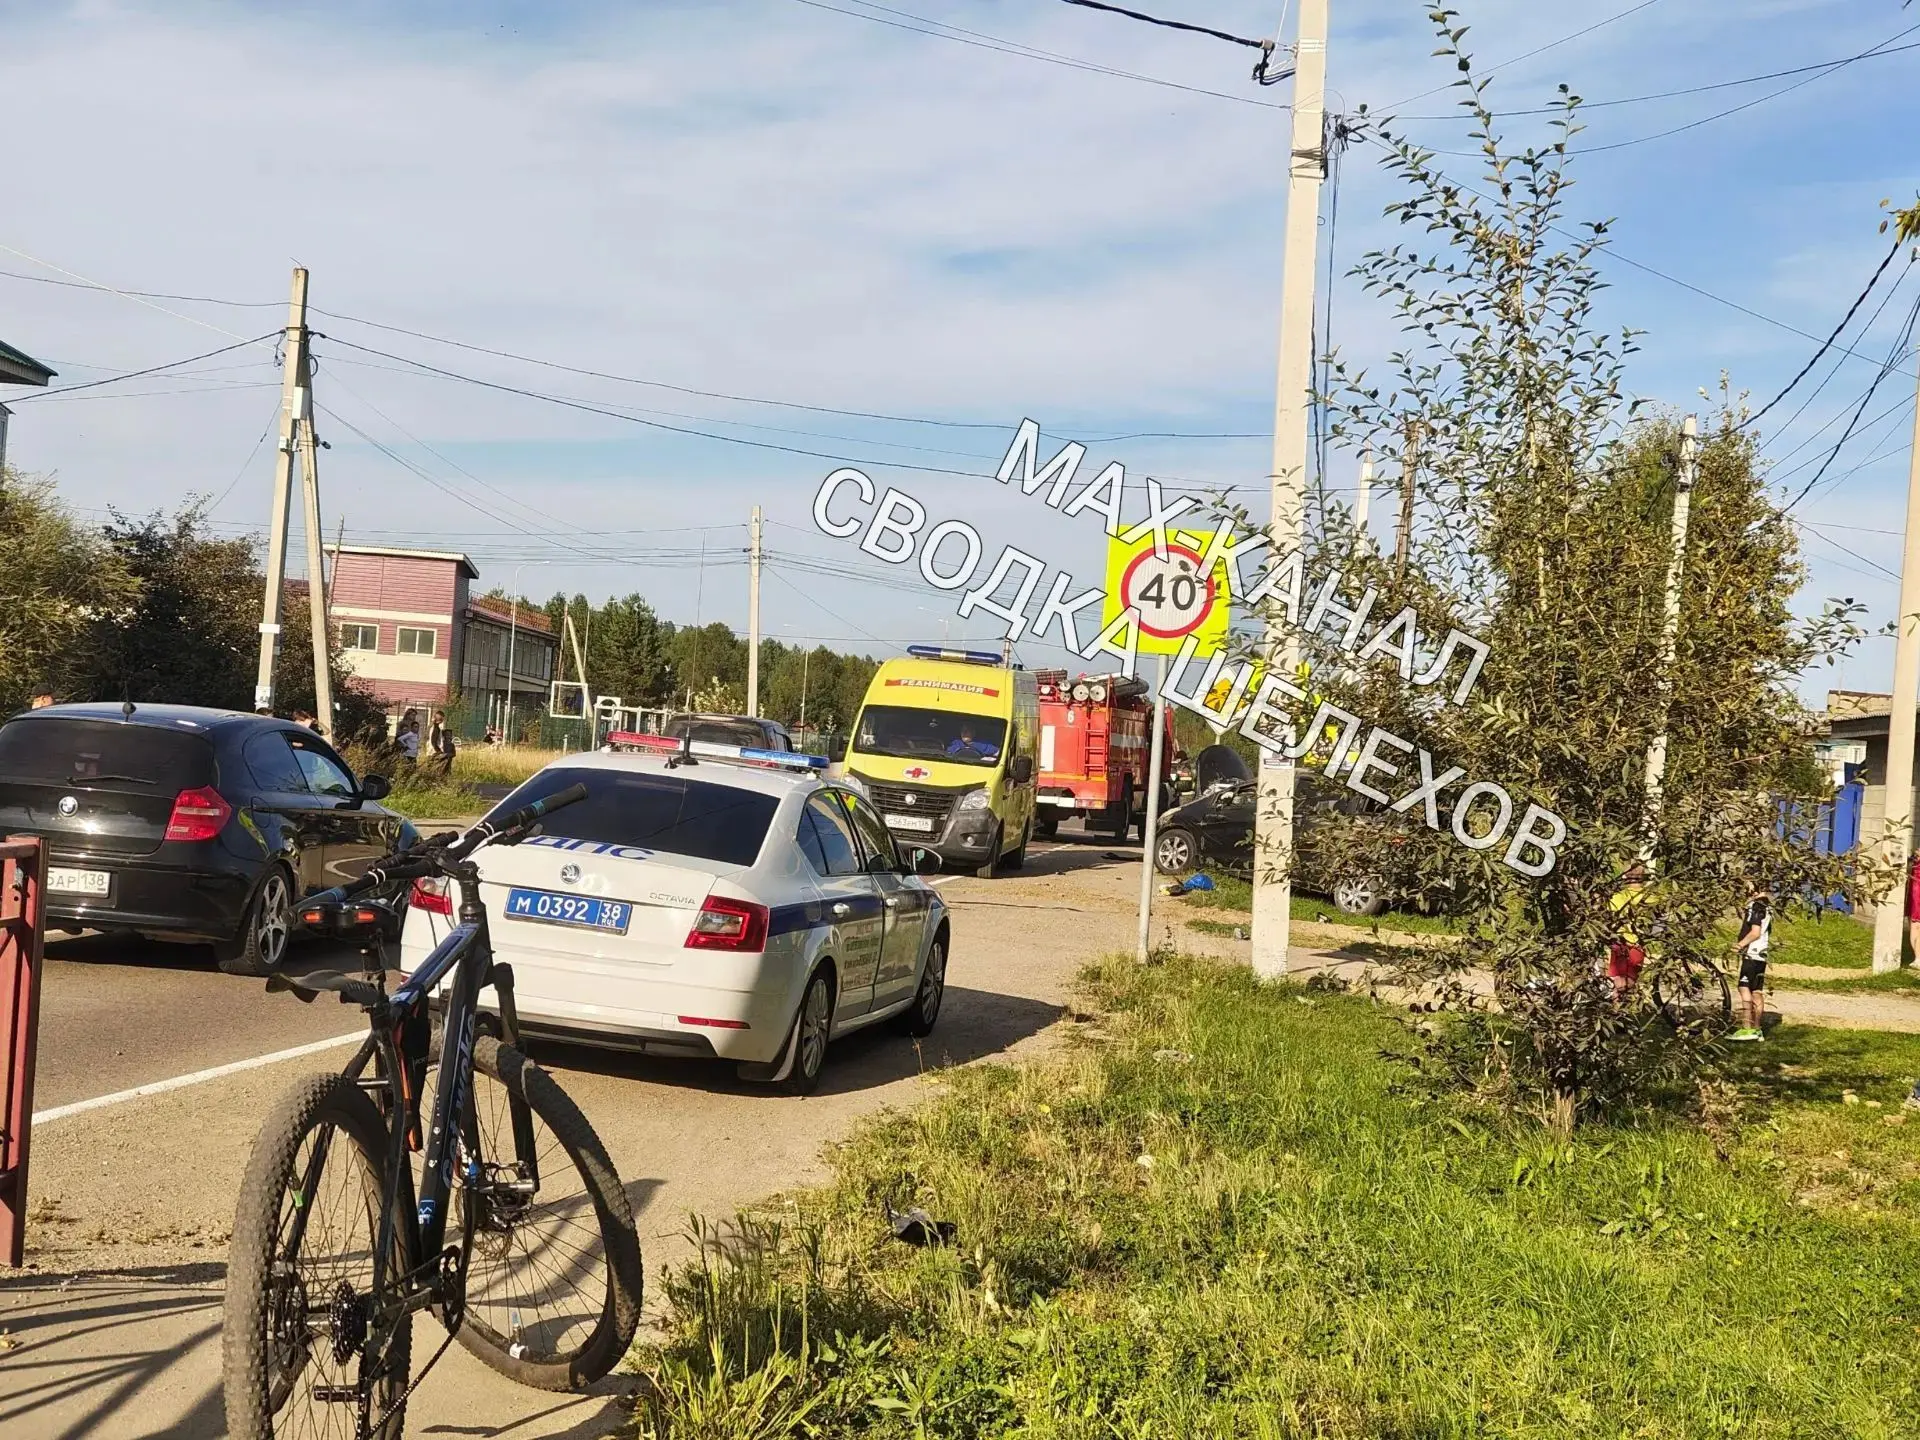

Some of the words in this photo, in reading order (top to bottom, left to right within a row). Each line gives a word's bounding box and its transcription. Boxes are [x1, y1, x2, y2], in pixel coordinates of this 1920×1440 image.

[1138, 573, 1196, 611] 40
[900, 679, 985, 694] РЕАНИМАЦИЯ
[521, 835, 655, 860] ДПС
[81, 873, 105, 887] 138
[537, 896, 589, 921] 0392
[601, 903, 622, 920] 38
[649, 892, 696, 905] OCTAVIA
